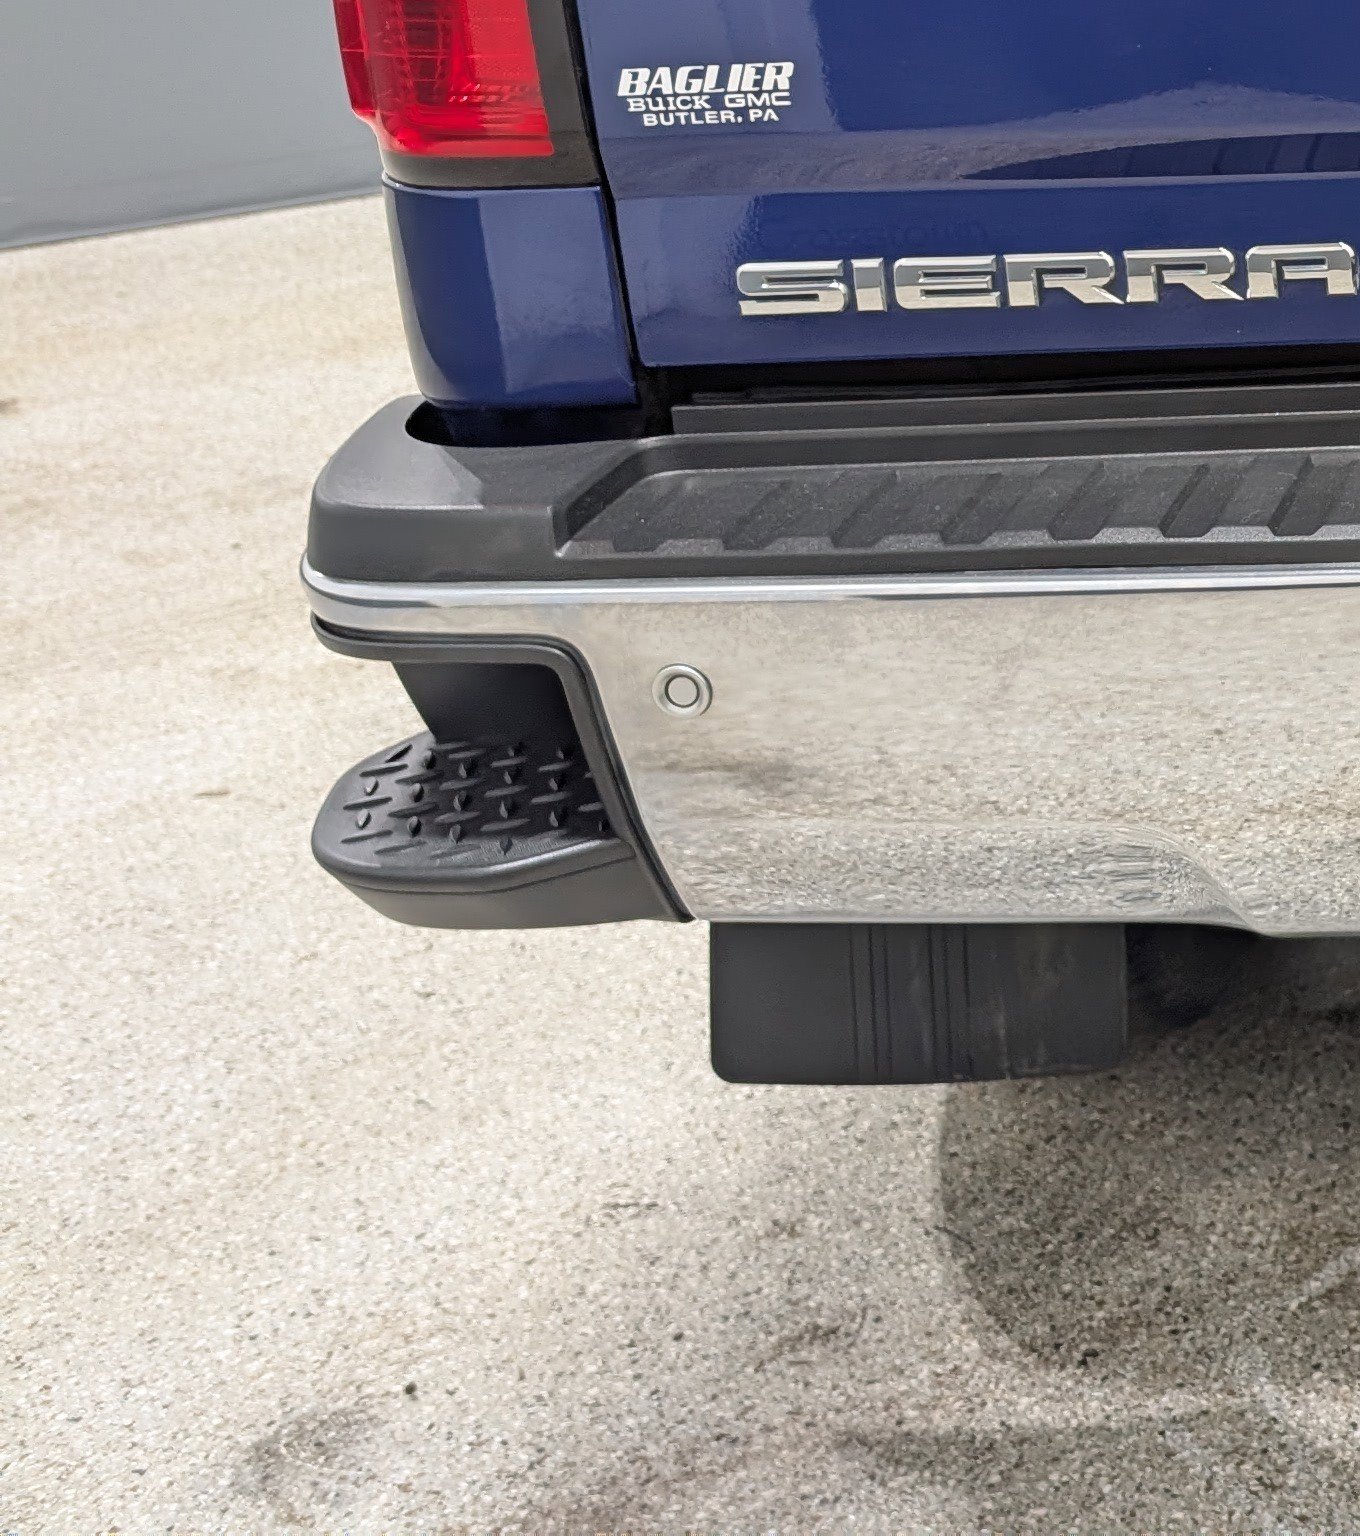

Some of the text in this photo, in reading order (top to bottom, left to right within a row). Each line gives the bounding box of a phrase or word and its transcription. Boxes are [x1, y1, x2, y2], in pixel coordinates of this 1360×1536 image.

[617, 61, 795, 97] BAGLIER
[626, 91, 792, 112] BUICK GMC
[749, 108, 780, 123] PA
[735, 241, 1360, 316] SIERRA
